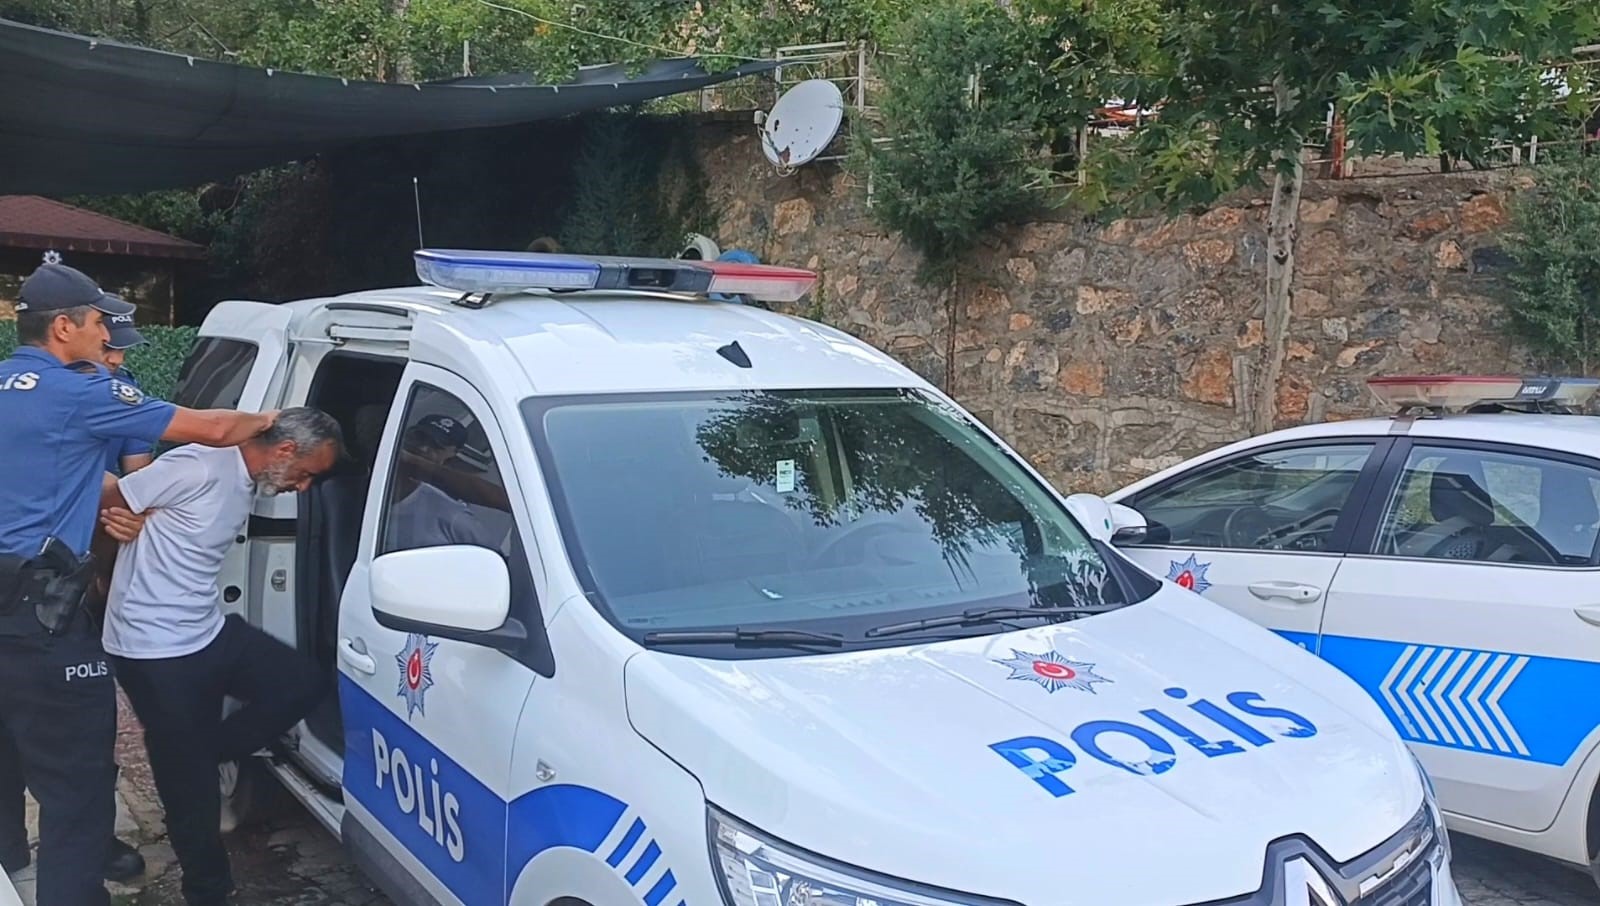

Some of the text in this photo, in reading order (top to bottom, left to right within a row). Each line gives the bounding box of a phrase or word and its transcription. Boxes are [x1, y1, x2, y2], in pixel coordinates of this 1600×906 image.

[65, 661, 108, 681] POLİS
[372, 727, 465, 863] POLİS
[988, 687, 1318, 798] POLİS
